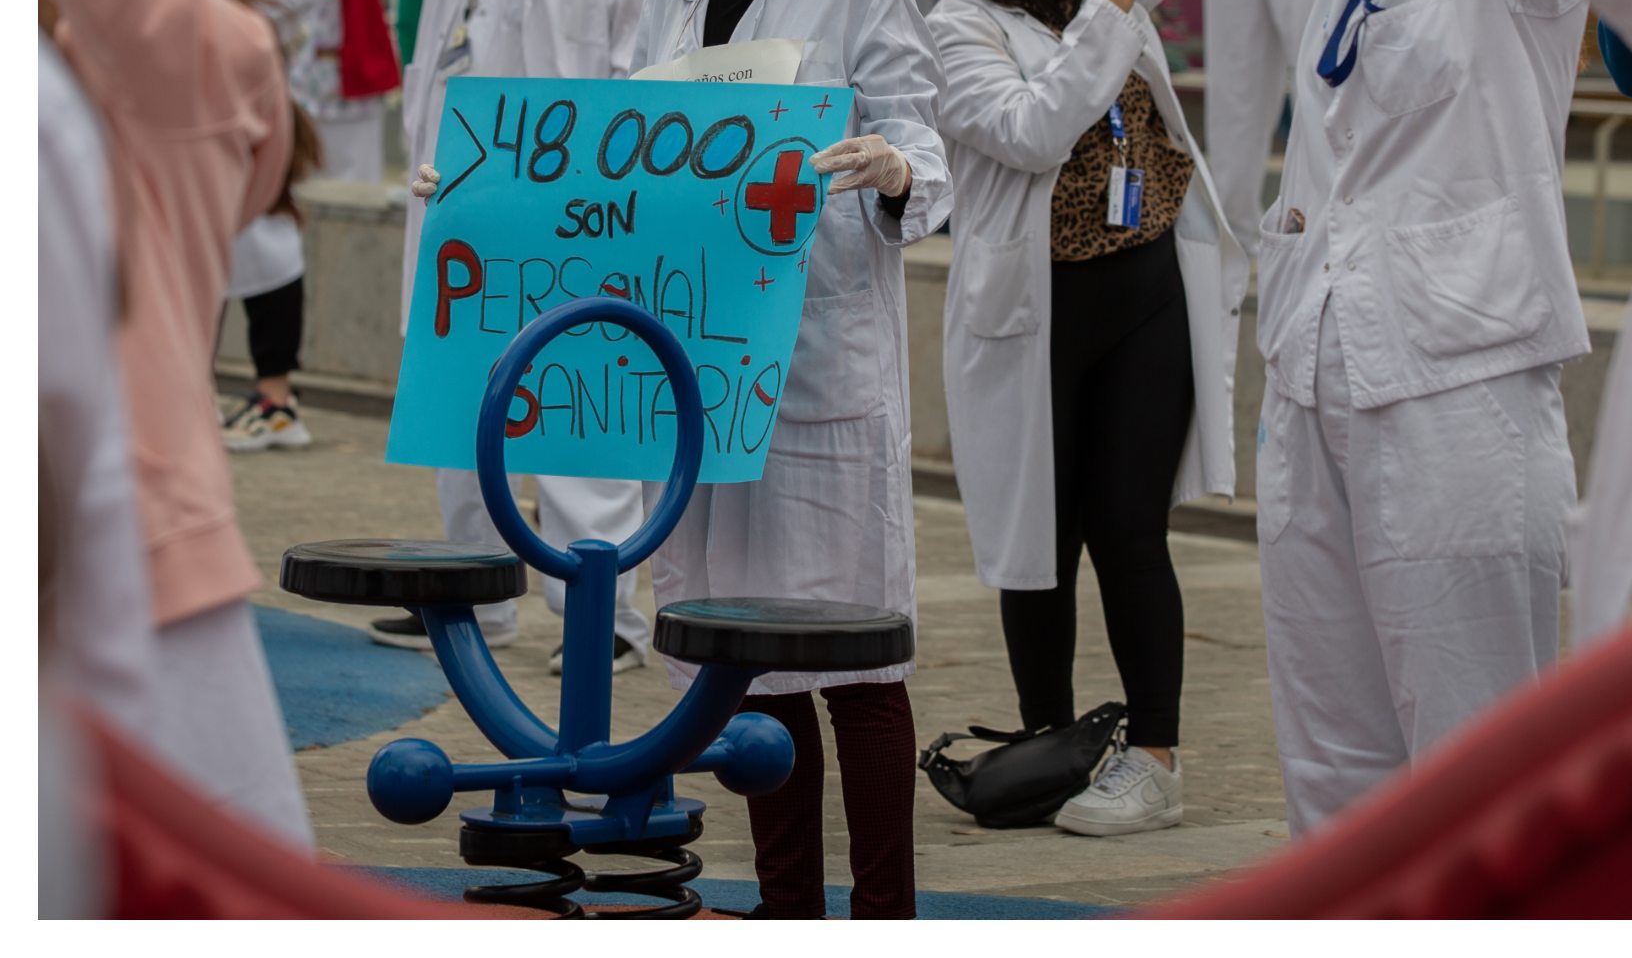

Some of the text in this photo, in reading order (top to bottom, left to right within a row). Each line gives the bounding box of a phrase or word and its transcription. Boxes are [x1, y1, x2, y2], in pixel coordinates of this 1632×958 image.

[728, 68, 753, 82] con
[555, 191, 637, 240] SON
[434, 239, 748, 344] PERSONAL
